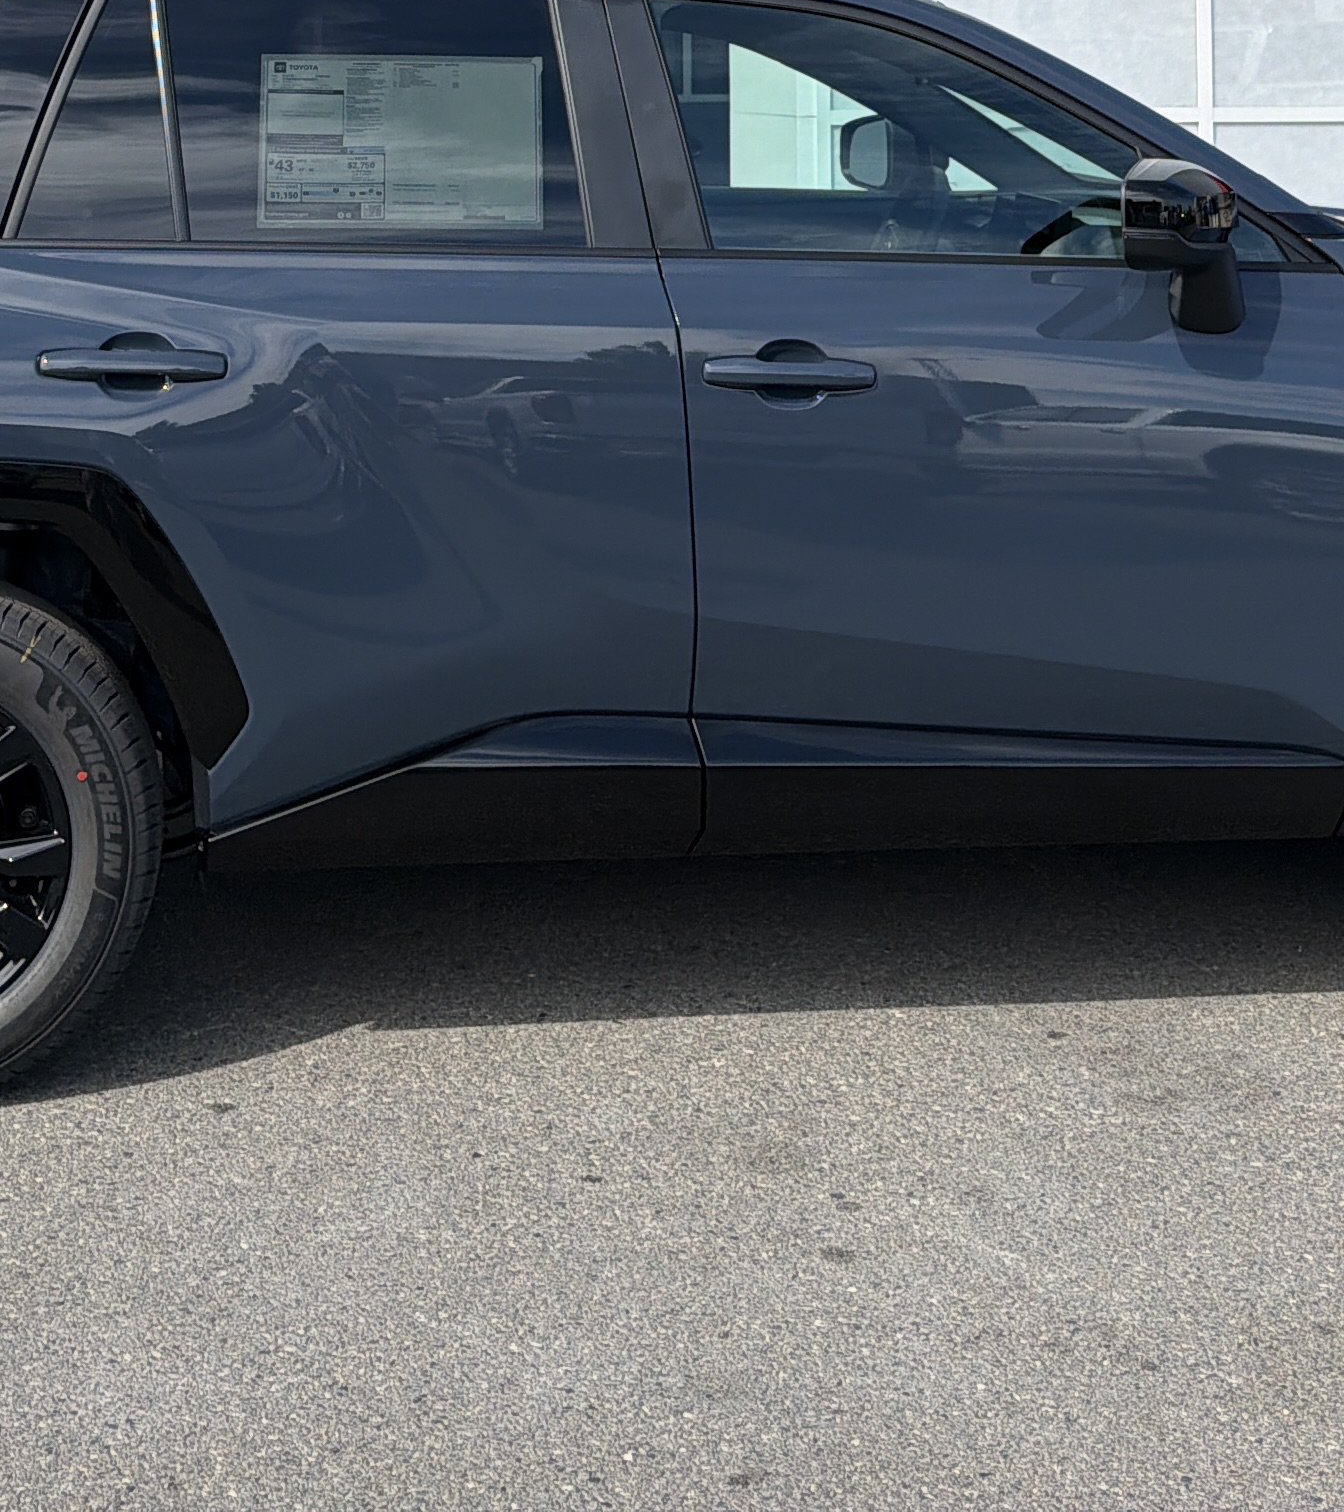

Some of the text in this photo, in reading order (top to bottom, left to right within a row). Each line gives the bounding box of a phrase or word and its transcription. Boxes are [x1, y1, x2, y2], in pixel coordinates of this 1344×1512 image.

[274, 159, 294, 172] 43
[347, 161, 375, 169] $2,750
[270, 191, 298, 199] $1,150
[69, 724, 123, 880] MICHELIN
